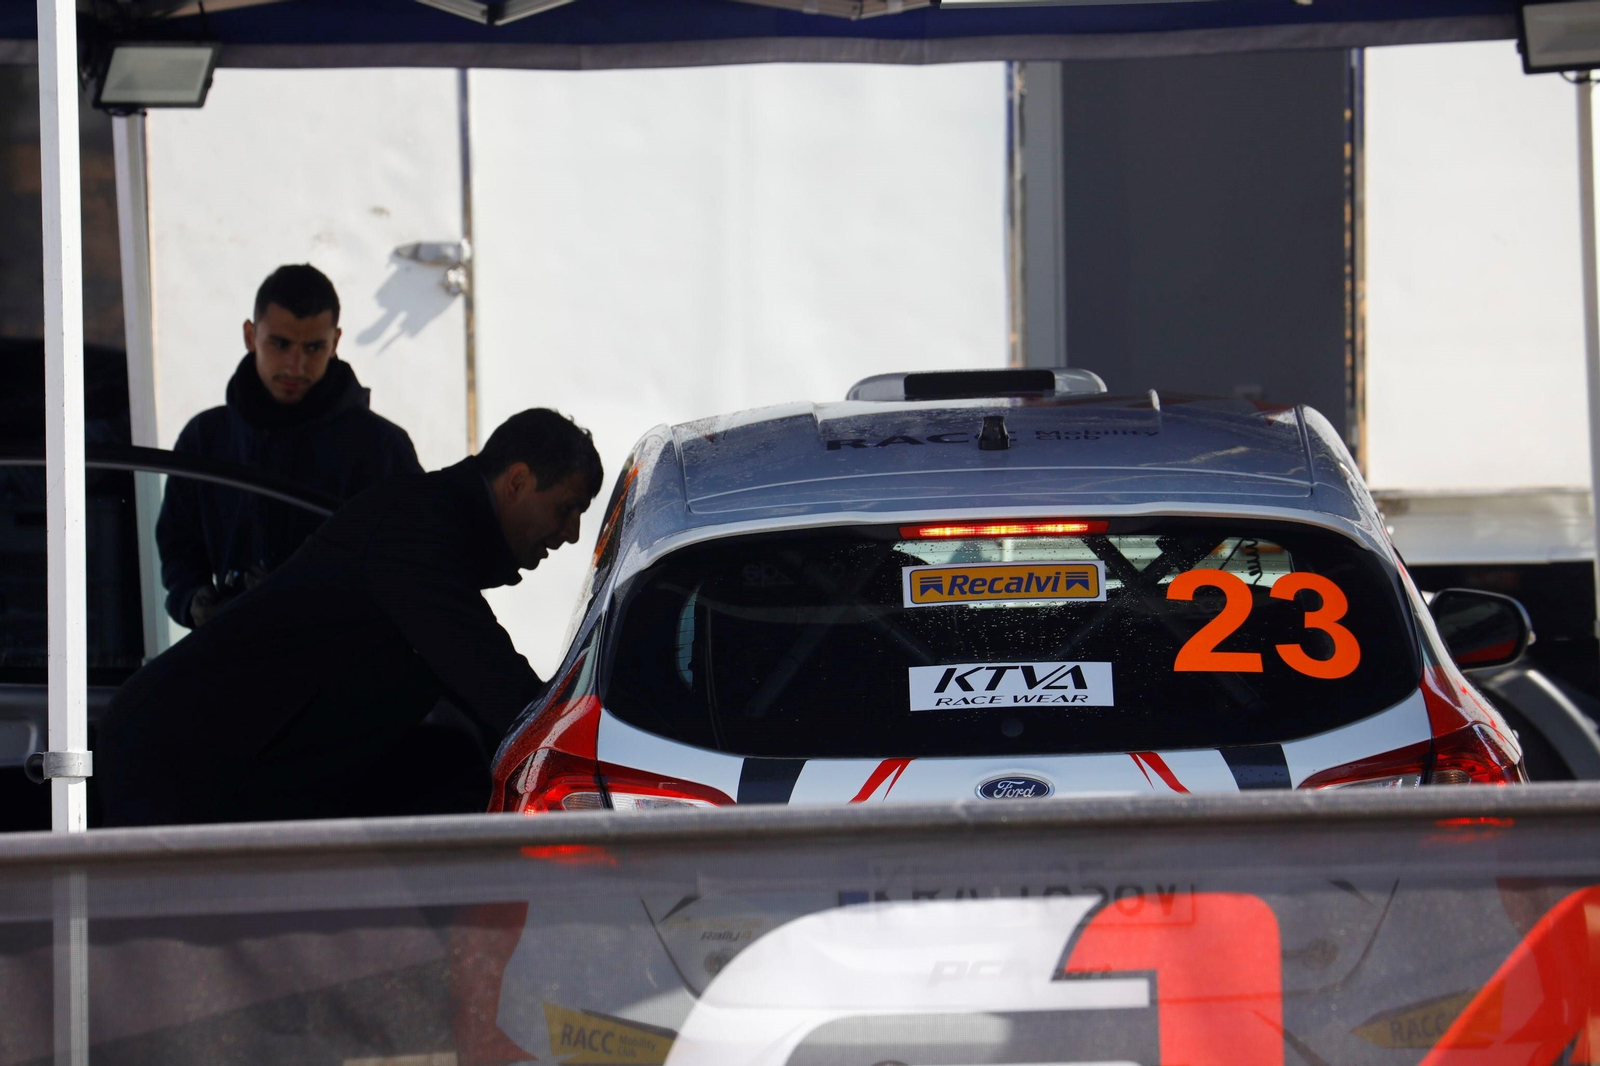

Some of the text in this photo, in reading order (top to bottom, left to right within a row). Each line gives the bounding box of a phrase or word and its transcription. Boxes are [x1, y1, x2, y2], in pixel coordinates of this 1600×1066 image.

[826, 432, 1018, 450] RAC
[947, 571, 1062, 596] Recalvi
[1166, 569, 1361, 679] 23
[933, 664, 1088, 694] KTVA
[934, 694, 1089, 707] RACE WEAR
[993, 780, 1036, 799] Ford
[560, 1023, 658, 1054] RACC Mobility
[1389, 1012, 1446, 1043] RACC
[617, 1047, 638, 1058] Club
